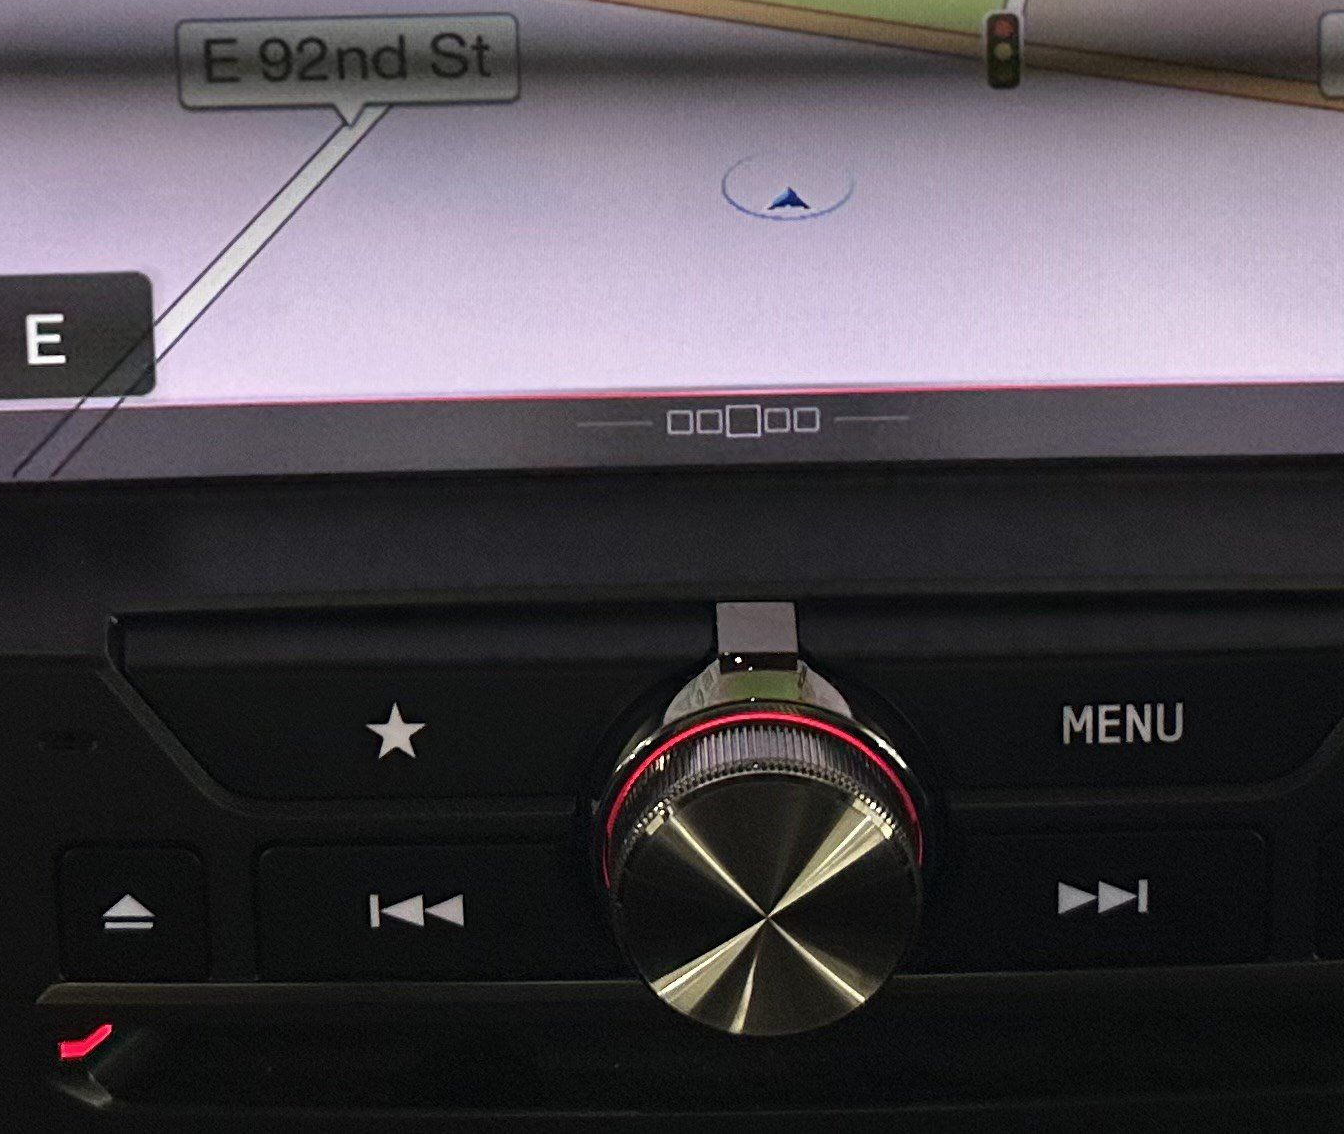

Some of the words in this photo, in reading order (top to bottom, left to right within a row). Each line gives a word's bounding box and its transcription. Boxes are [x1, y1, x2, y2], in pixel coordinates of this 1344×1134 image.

[203, 37, 242, 84] E
[258, 34, 407, 83] 92nd
[429, 31, 492, 80] St
[25, 312, 67, 365] E
[1061, 700, 1186, 746] MENU
